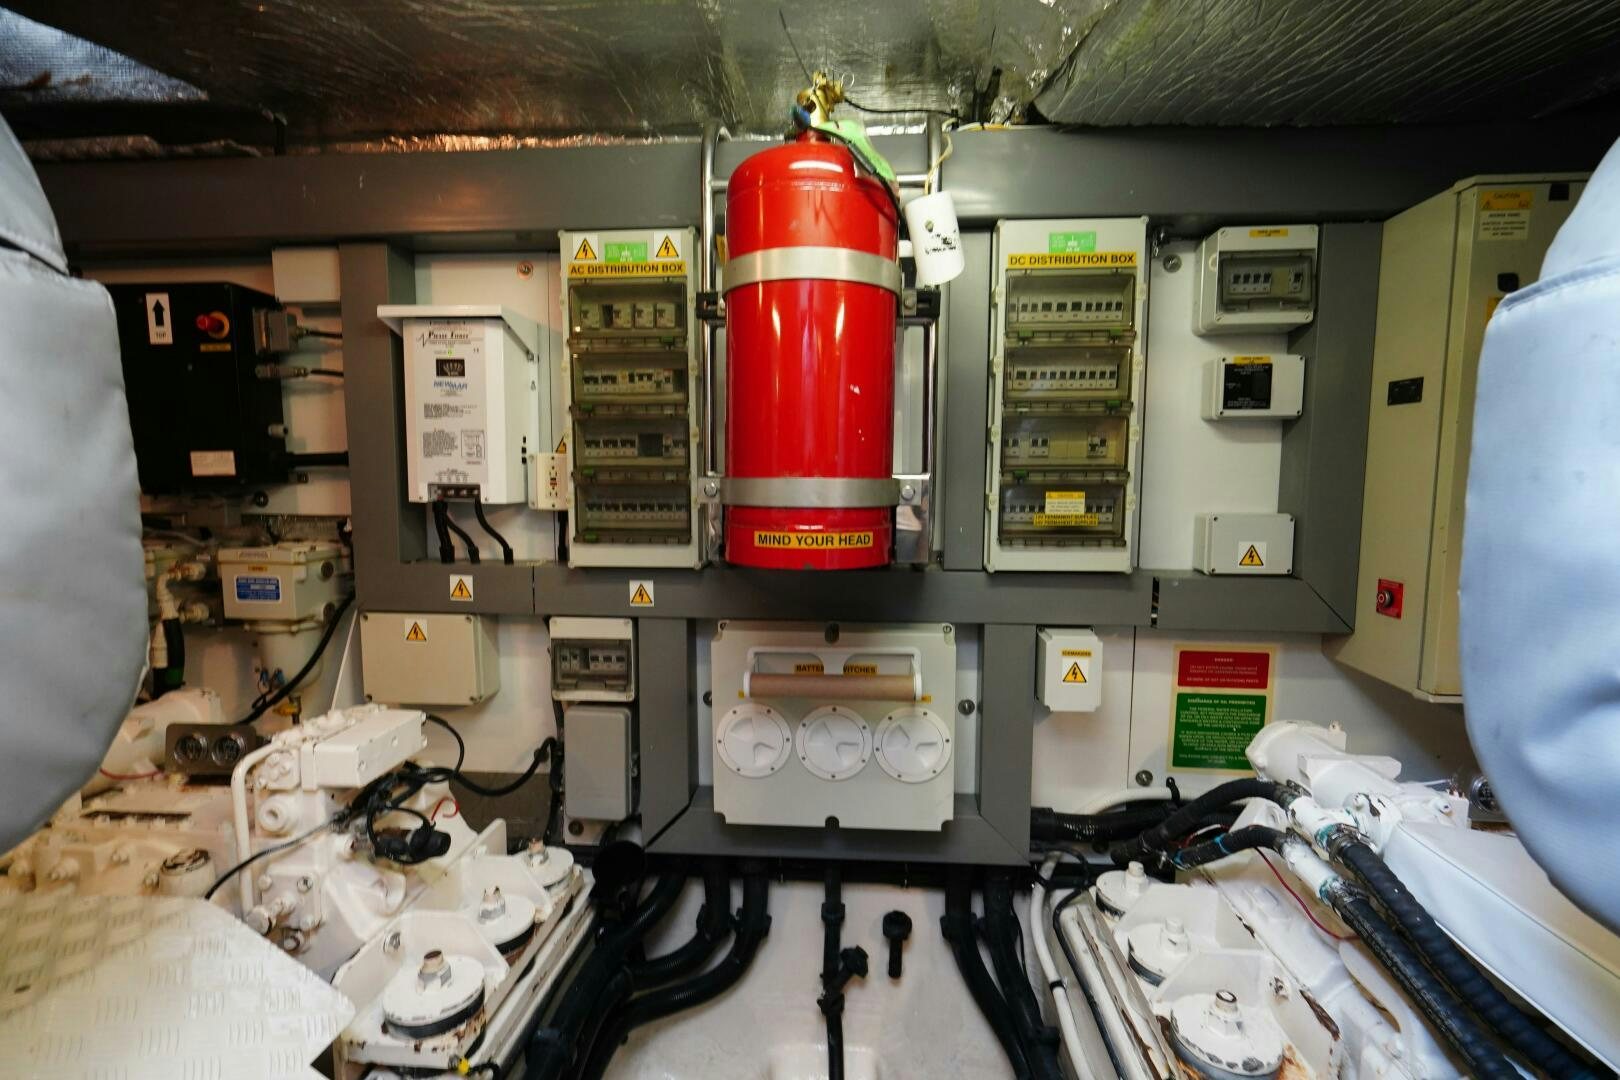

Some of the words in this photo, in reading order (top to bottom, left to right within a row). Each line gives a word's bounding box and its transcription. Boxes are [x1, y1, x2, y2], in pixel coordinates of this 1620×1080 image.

[1010, 256, 1026, 266] DC
[1029, 255, 1107, 265] DISTRIBUTION
[1111, 254, 1134, 264] BOX
[571, 265, 584, 274] AC
[587, 264, 658, 274] DISTRIBUTION
[662, 263, 683, 272] BOX
[758, 534, 791, 545] MIND
[796, 535, 834, 546] YOUR
[839, 534, 870, 545] HEAD
